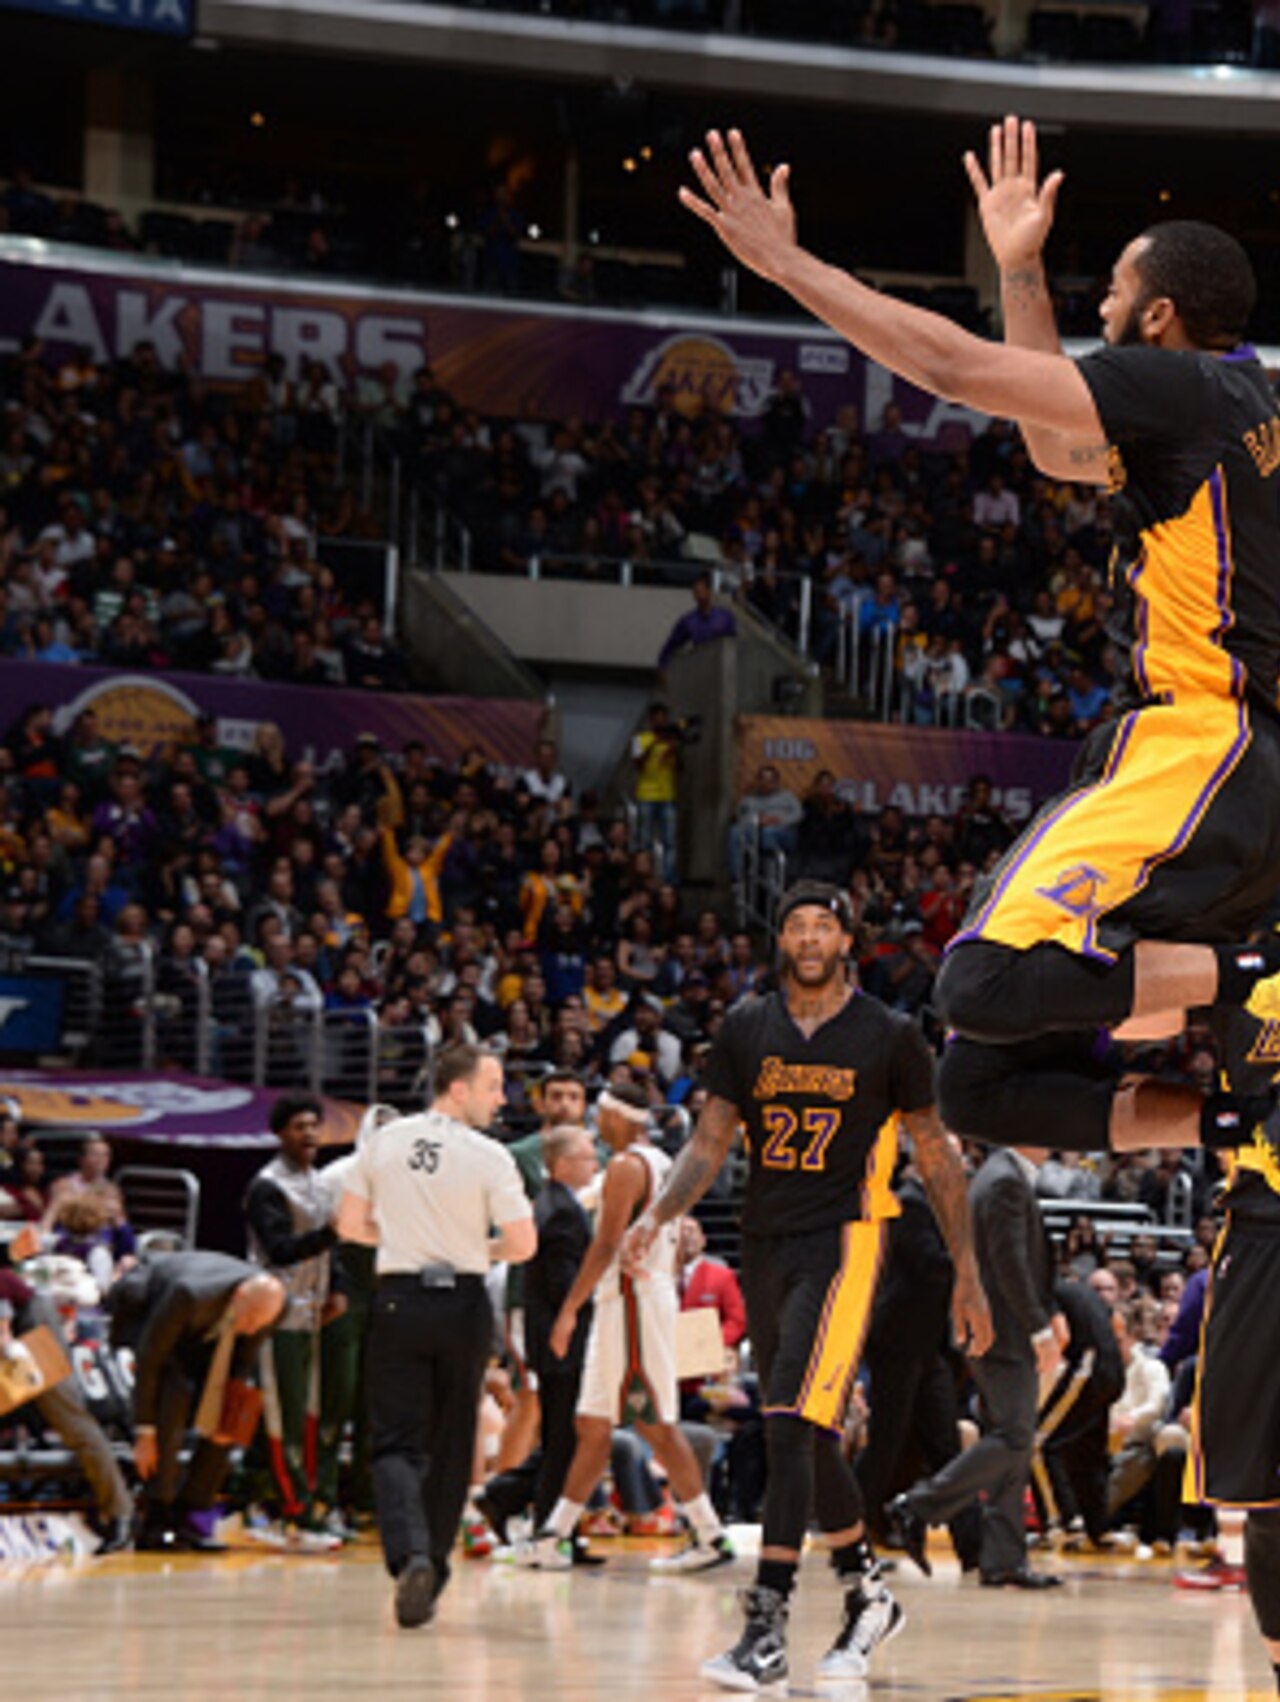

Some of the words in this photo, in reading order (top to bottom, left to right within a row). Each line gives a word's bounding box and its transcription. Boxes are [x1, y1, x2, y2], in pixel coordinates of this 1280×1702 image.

[0, 282, 426, 390] AKERS
[407, 1139, 443, 1175] 35
[761, 1105, 841, 1170] 27
